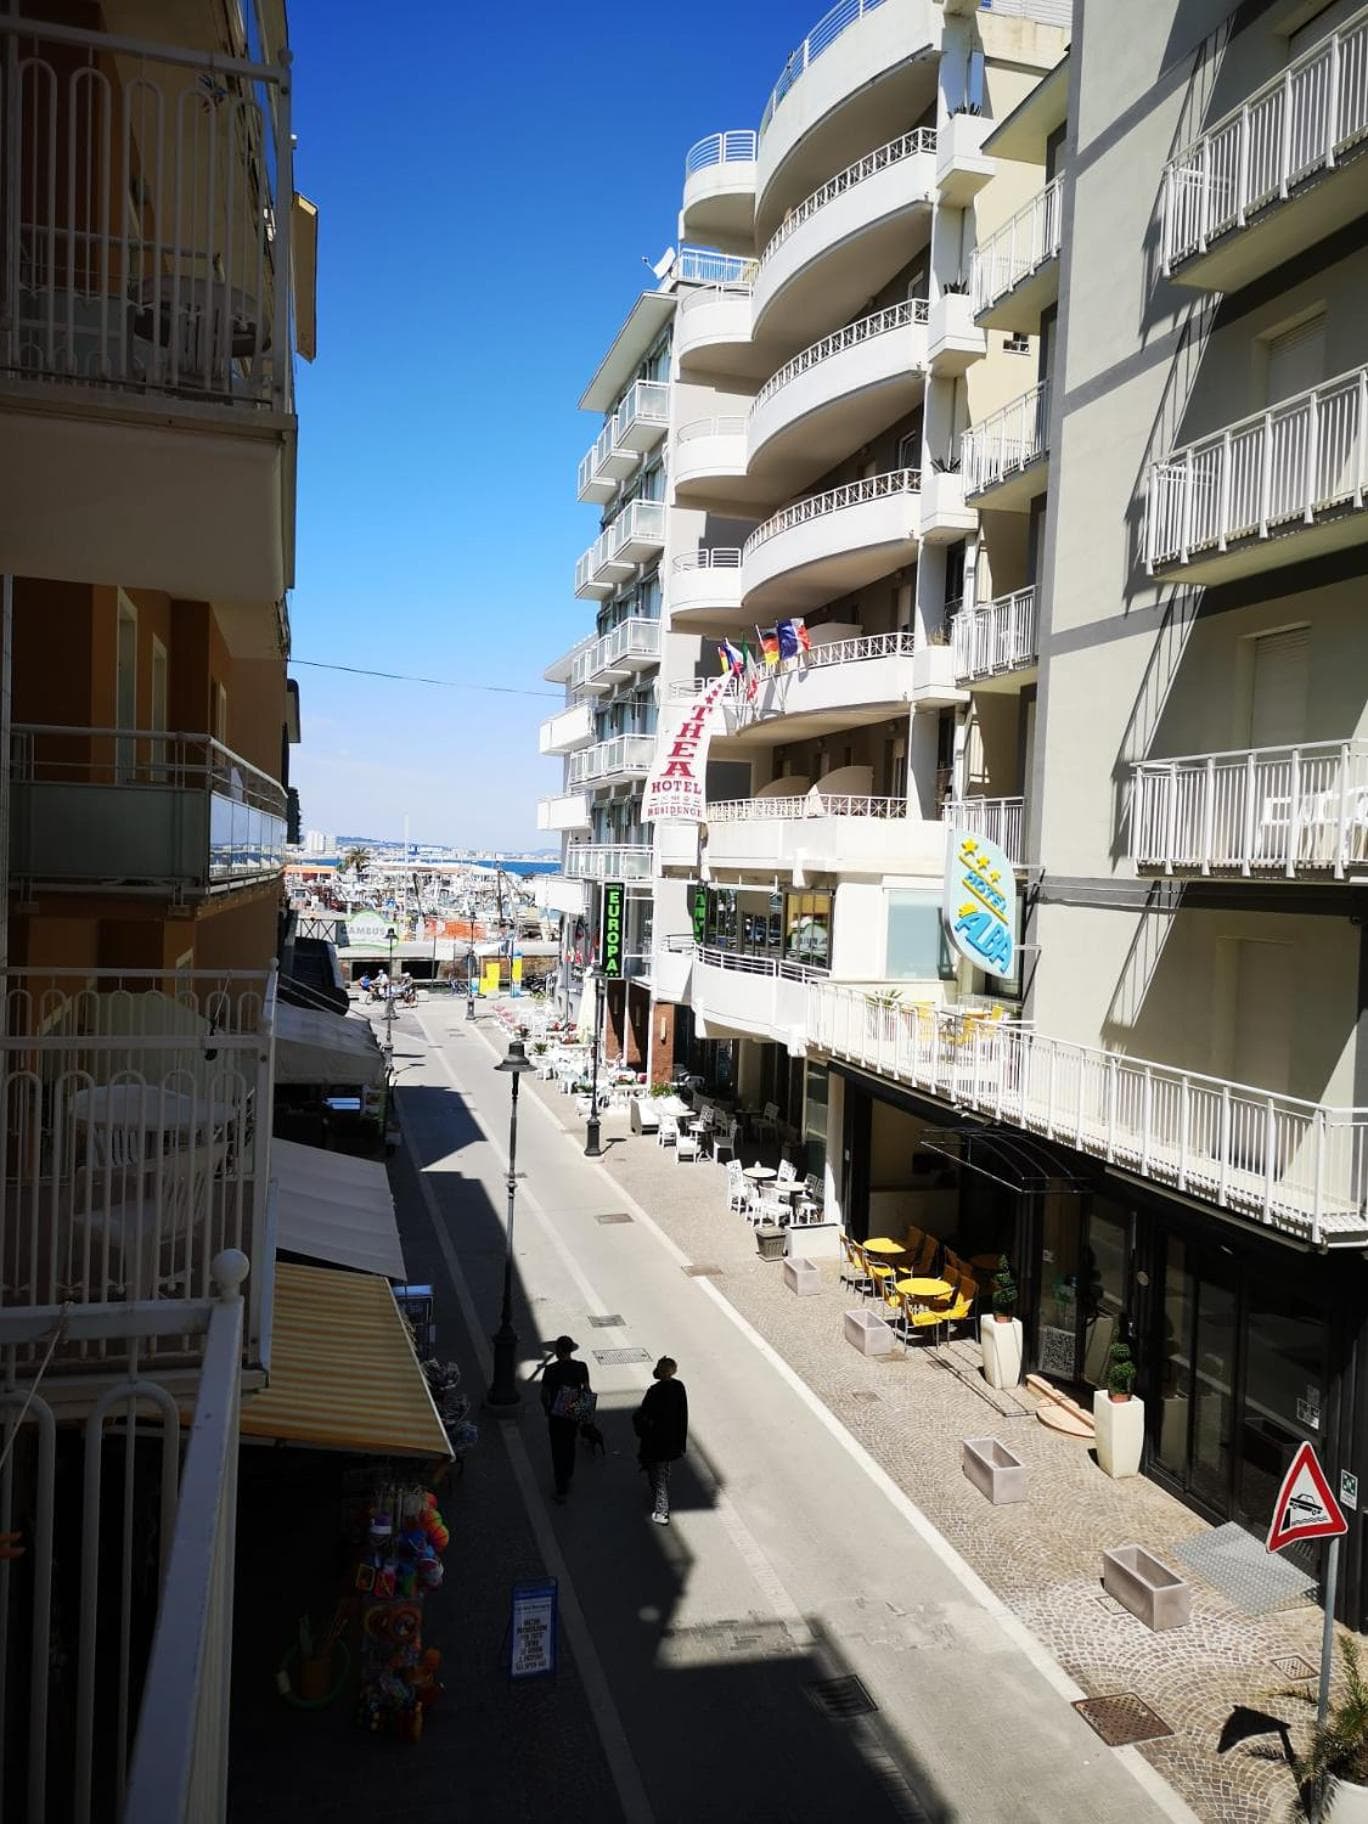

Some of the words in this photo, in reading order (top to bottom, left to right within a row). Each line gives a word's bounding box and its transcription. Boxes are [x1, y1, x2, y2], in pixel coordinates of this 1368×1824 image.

[660, 704, 712, 778] THEA
[651, 780, 702, 795] HOTEL
[965, 870, 1007, 911] HOTEL
[606, 891, 620, 971] EUROPA
[954, 911, 1012, 974] ALBA
